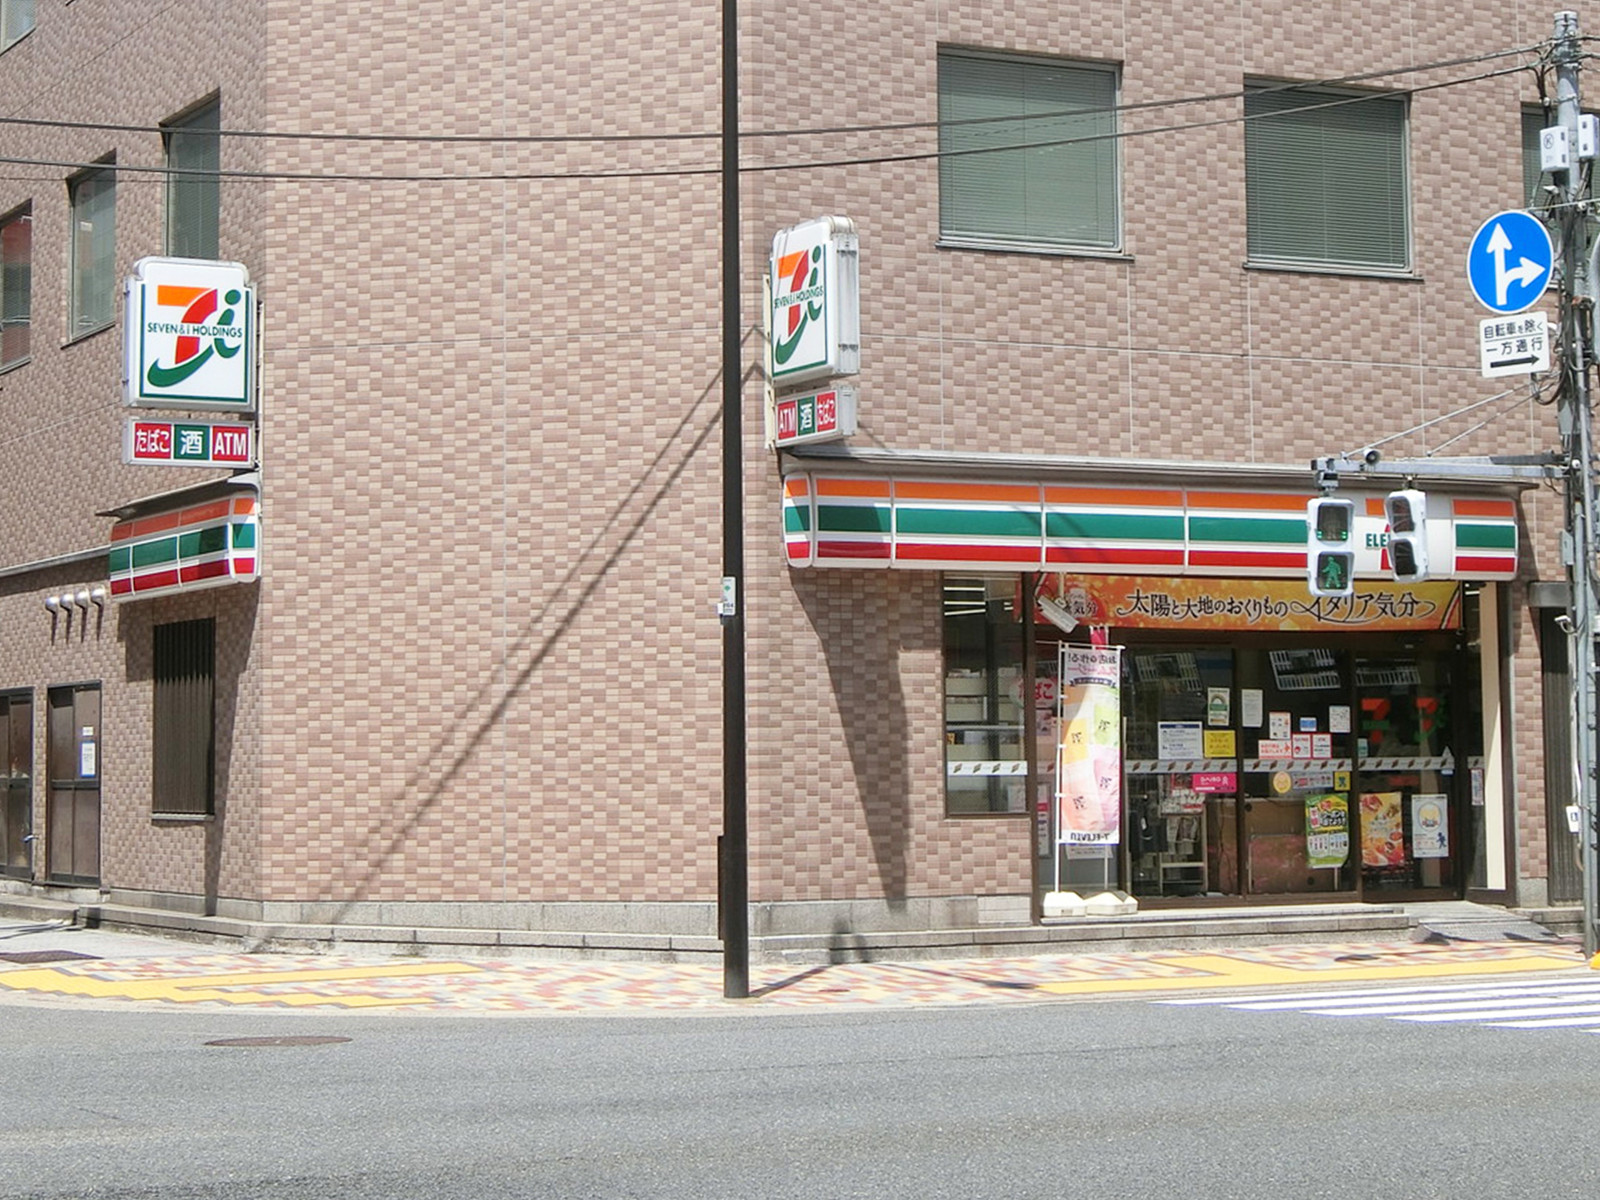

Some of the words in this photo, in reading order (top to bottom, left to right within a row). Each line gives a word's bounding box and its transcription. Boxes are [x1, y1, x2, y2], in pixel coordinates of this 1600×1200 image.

[148, 322, 178, 334] SEVEN
[192, 325, 243, 338] HOLDINGS
[1484, 319, 1543, 339] 自転車を除く
[1486, 337, 1542, 355] 一方通行
[800, 403, 812, 430] 酒
[135, 428, 170, 453] たばこ
[180, 430, 203, 455] 酒
[214, 432, 247, 456] ATM
[1365, 533, 1390, 547] ELE
